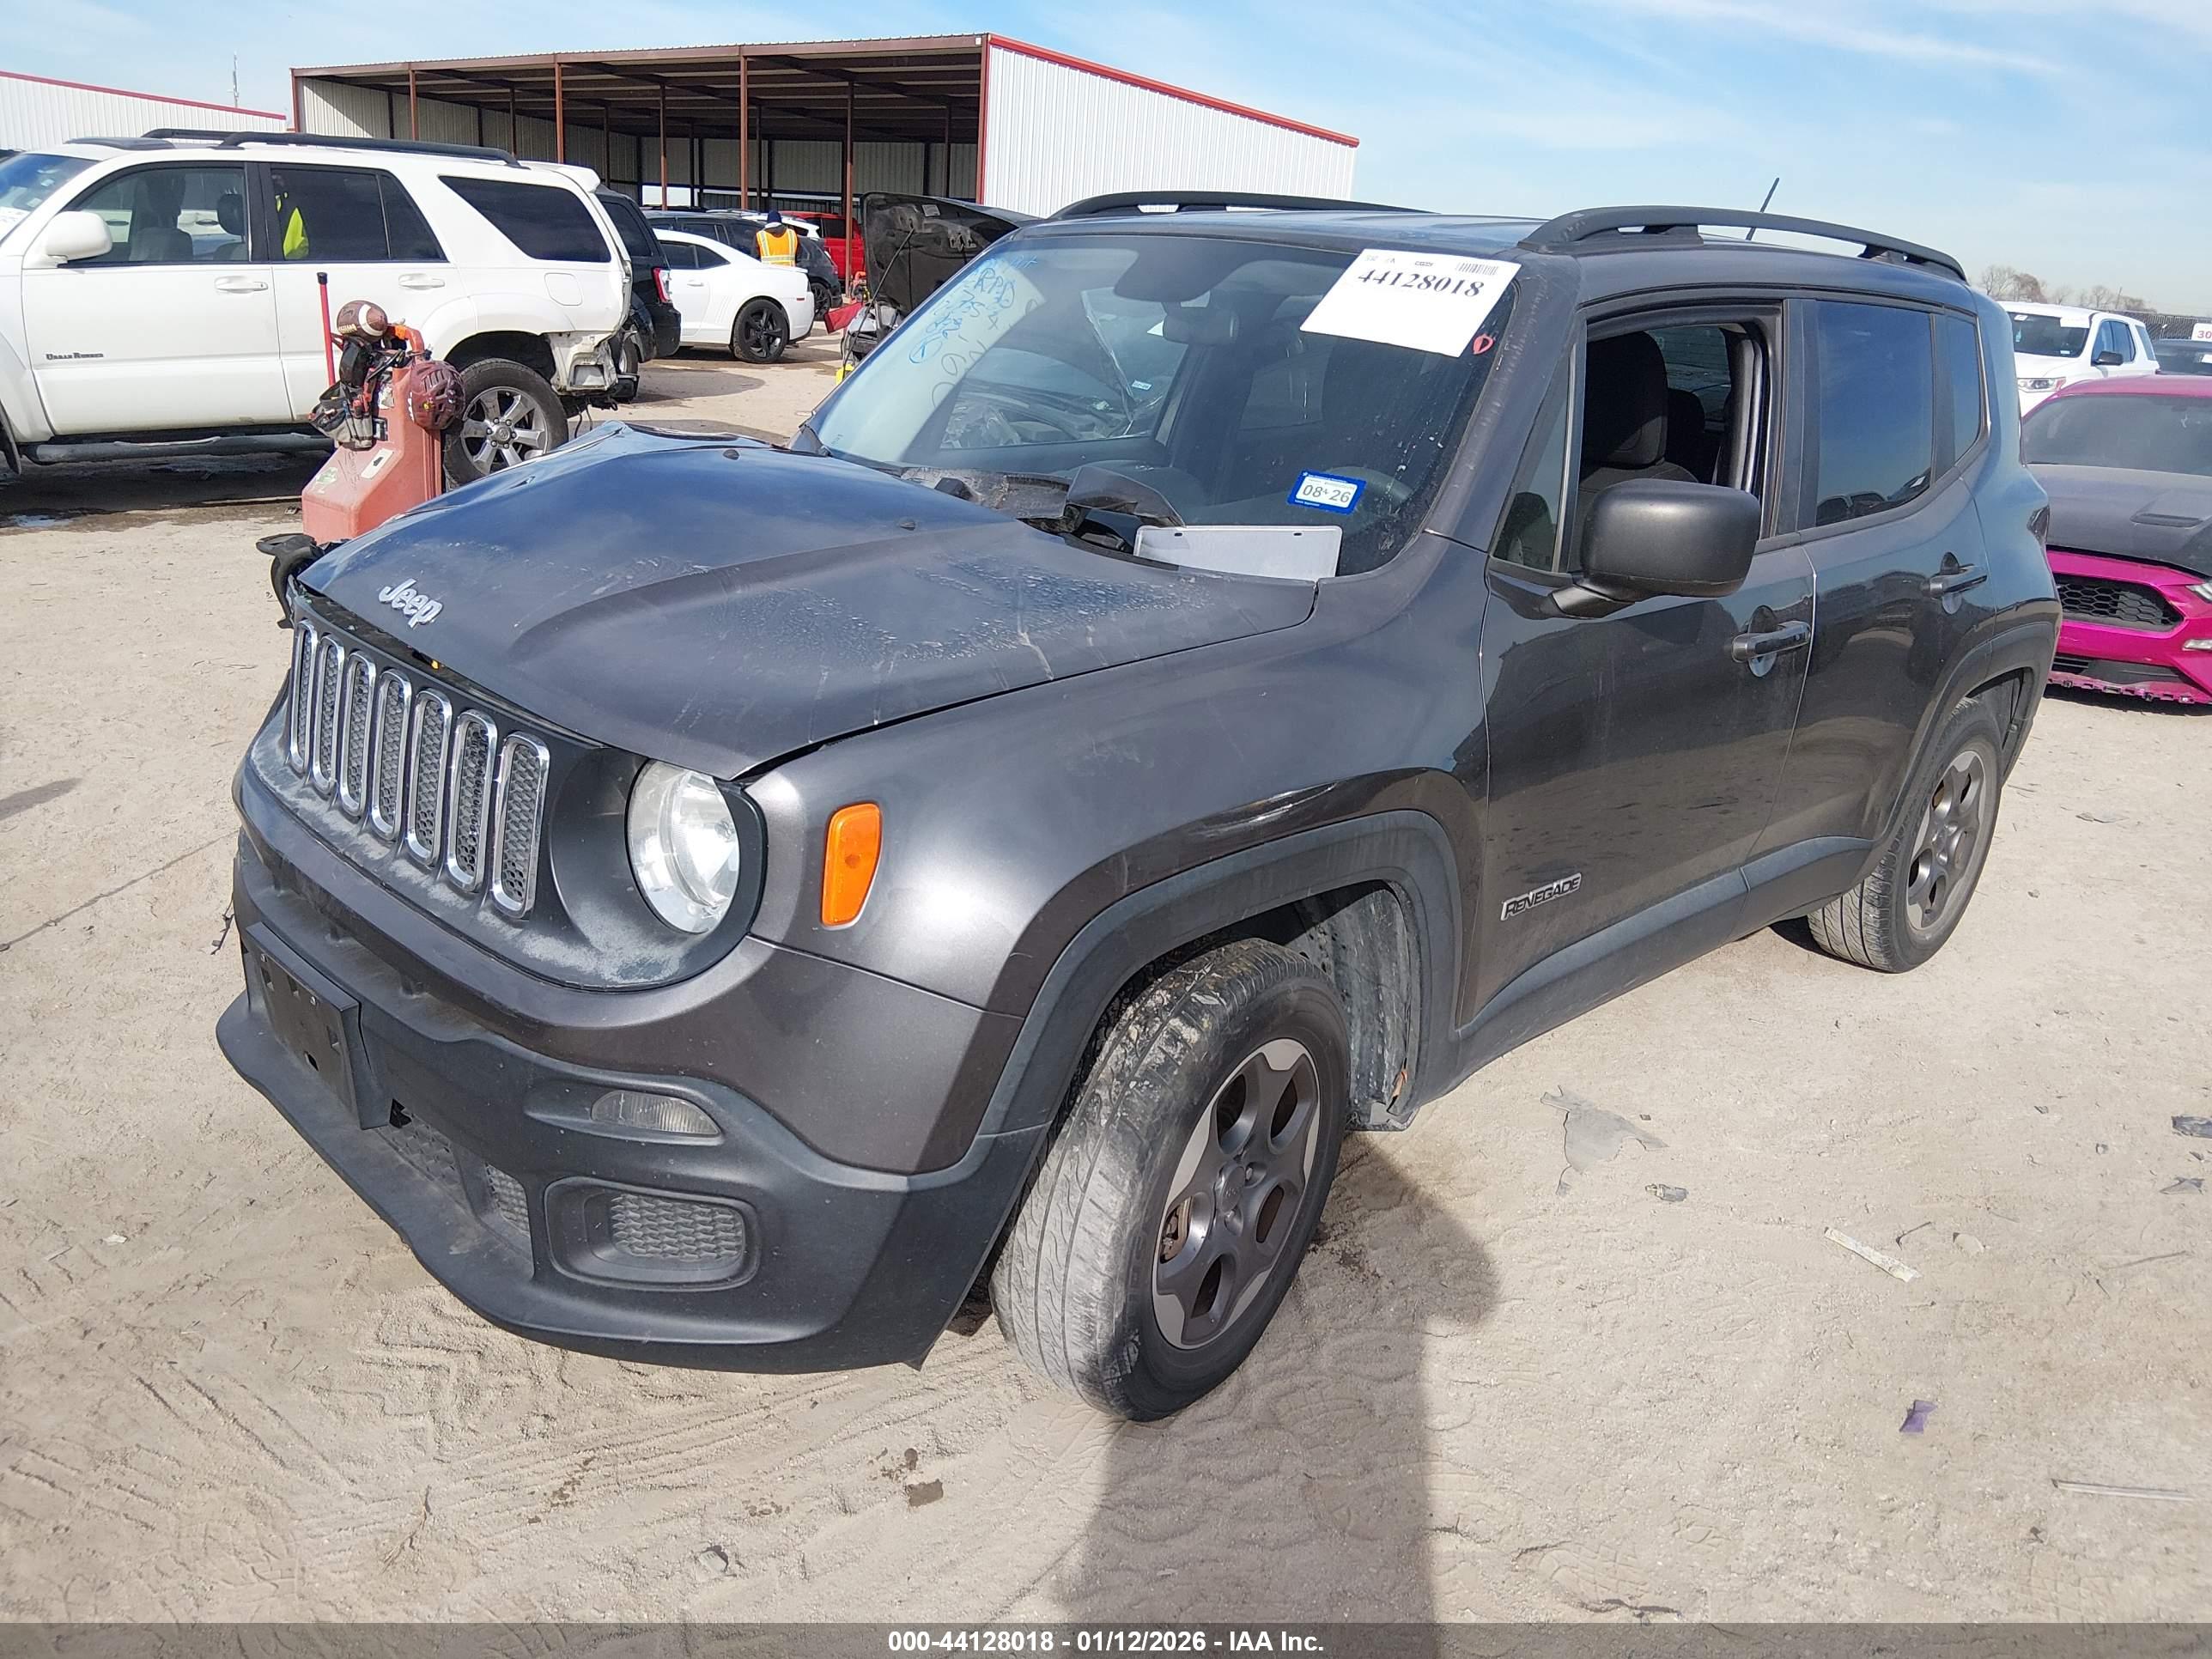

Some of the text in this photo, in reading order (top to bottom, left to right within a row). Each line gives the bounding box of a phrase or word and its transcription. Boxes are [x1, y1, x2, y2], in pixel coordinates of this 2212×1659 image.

[1358, 269, 1485, 297] 44128018
[378, 578, 444, 629] Jeep
[1500, 872, 1582, 921] RENEGADE
